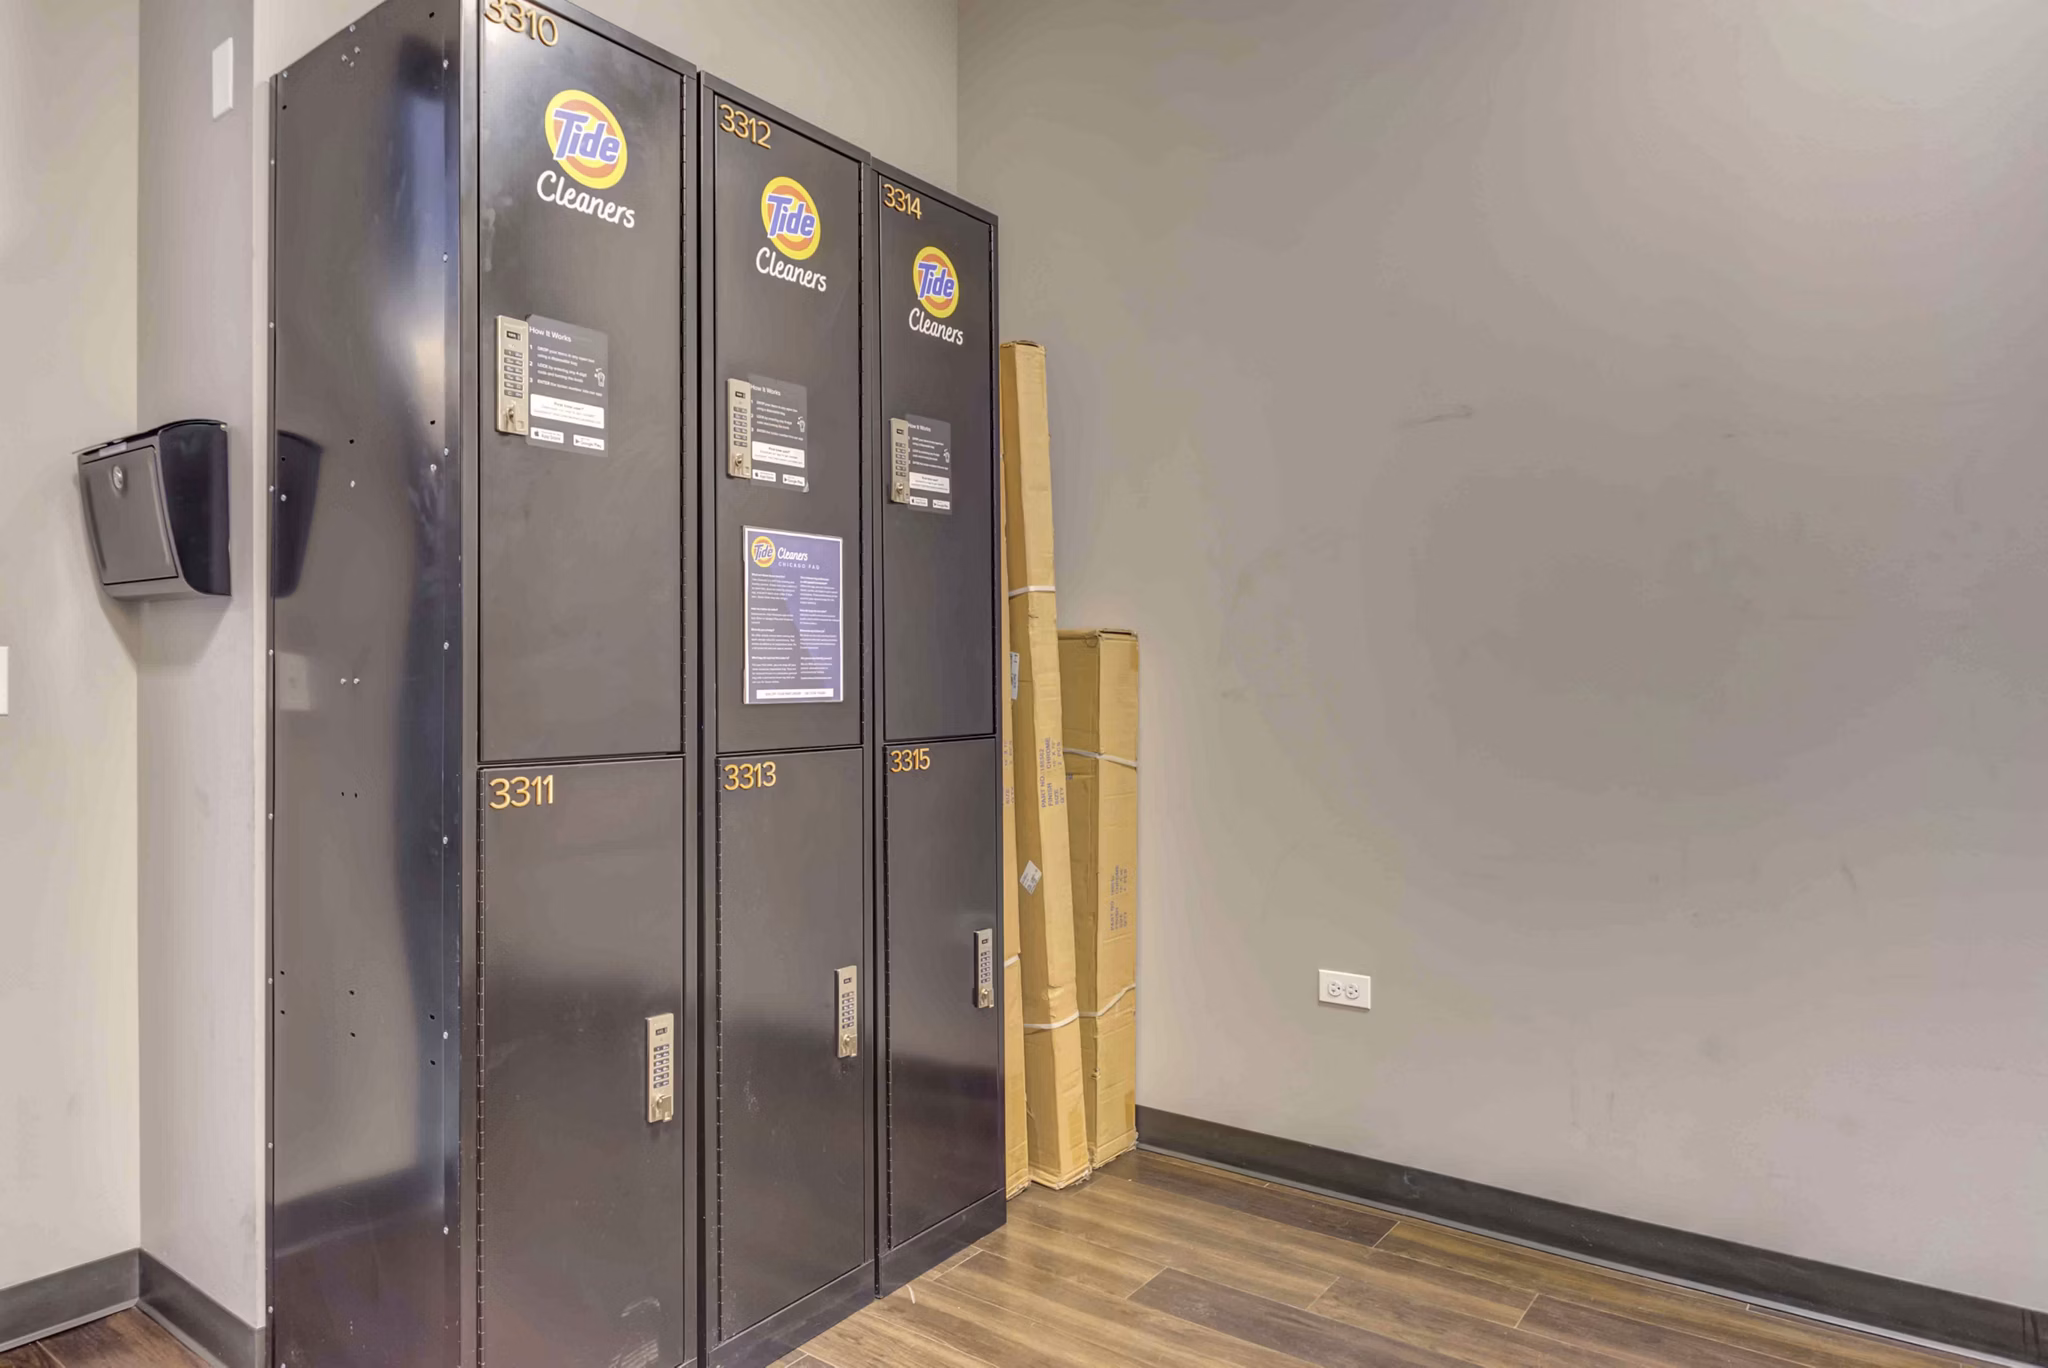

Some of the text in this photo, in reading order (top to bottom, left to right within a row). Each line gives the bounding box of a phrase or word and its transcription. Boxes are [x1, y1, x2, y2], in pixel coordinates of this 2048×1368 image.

[484, 0, 558, 47] 3310
[553, 108, 621, 164] Tide
[719, 104, 771, 149] 3312
[536, 170, 636, 229] Cleaners
[766, 193, 816, 239] Tide
[883, 183, 922, 220] 3314
[755, 247, 828, 292] Cleaners
[917, 260, 956, 300] Tide
[529, 326, 544, 336] How
[551, 331, 572, 342] Works
[908, 307, 964, 345] Cleaners
[754, 544, 808, 562] Tide Cleaners
[723, 761, 777, 791] 3313
[890, 747, 931, 773] 3315
[489, 774, 553, 810] 3311
